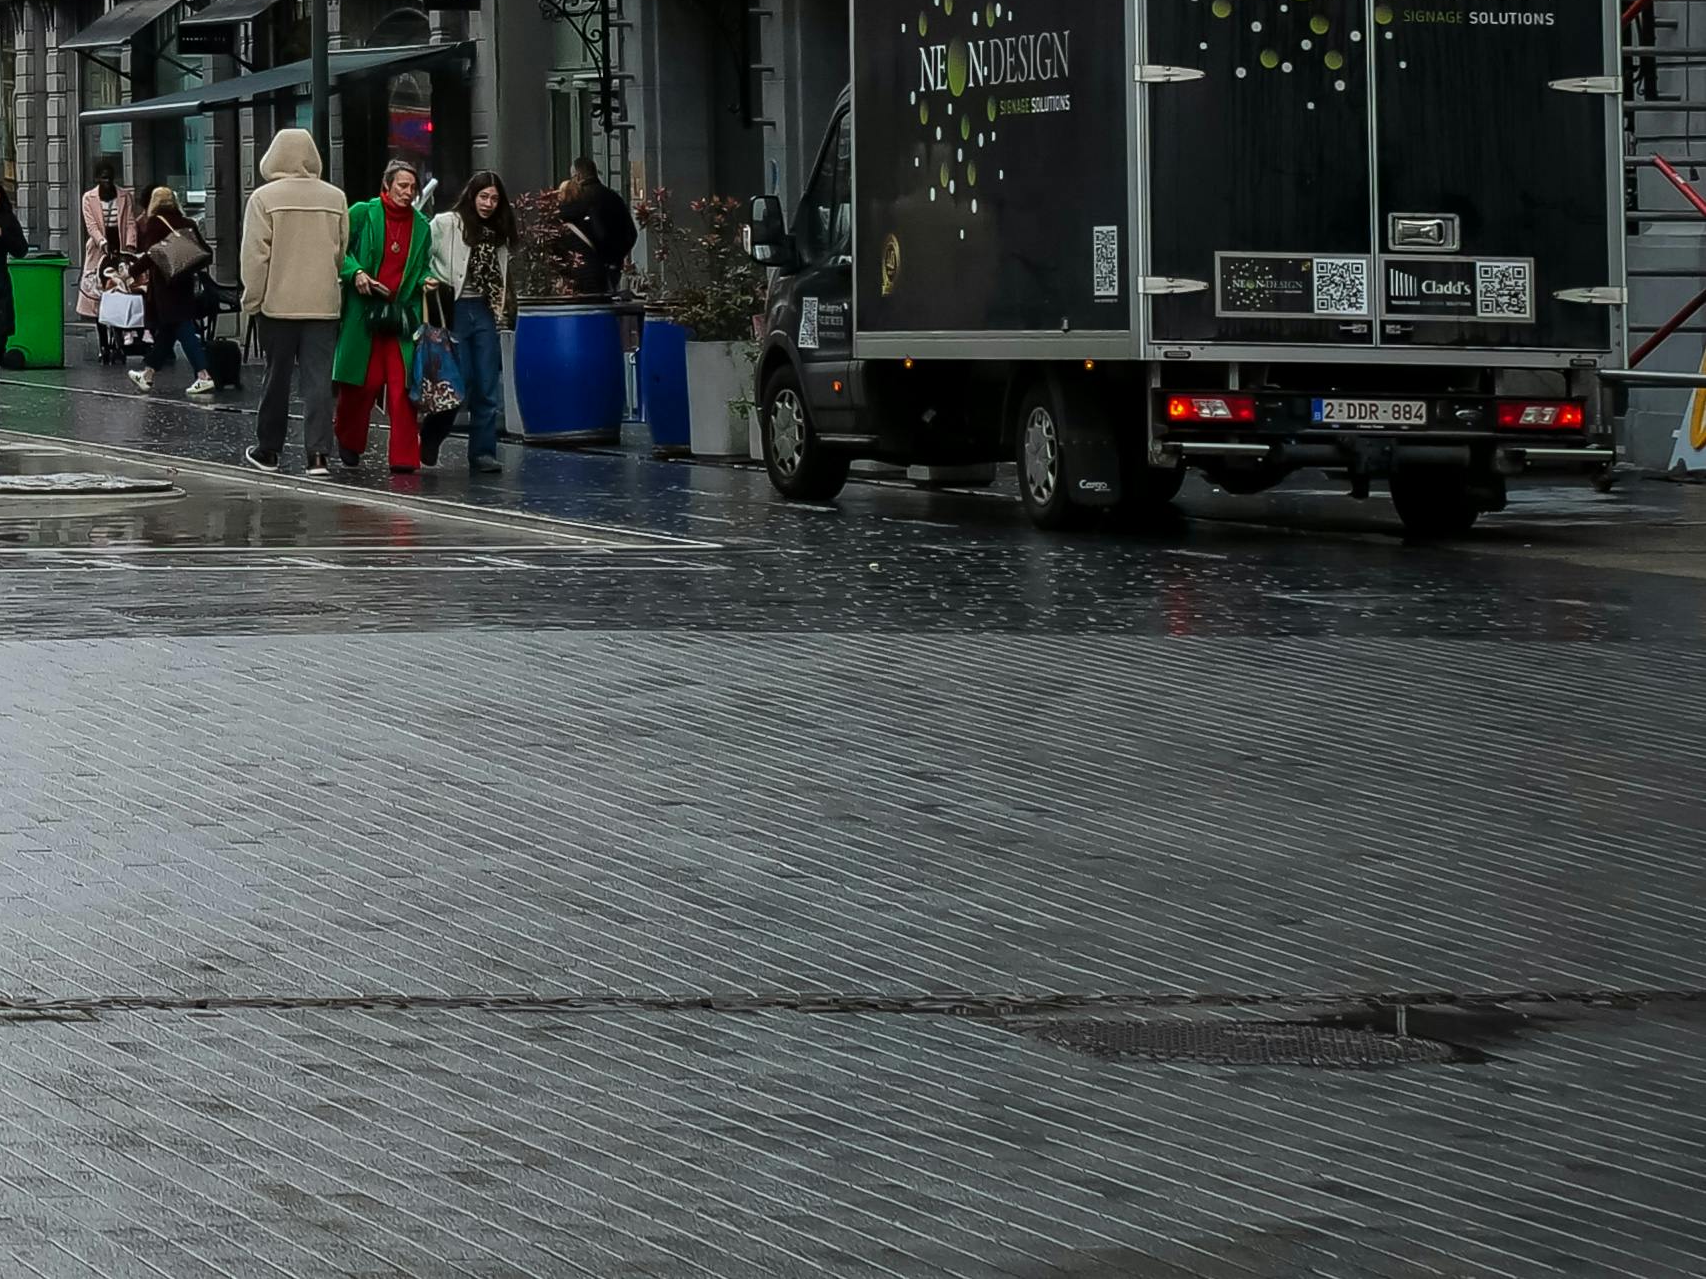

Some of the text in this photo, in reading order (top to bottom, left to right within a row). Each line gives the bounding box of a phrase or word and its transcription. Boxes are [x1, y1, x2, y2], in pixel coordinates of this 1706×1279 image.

[1403, 9, 1555, 26] SIGNAGE SOLUTIONS
[1000, 95, 1070, 115] SIGNAGE SOLUTIONS
[1421, 280, 1472, 295] Cladd's
